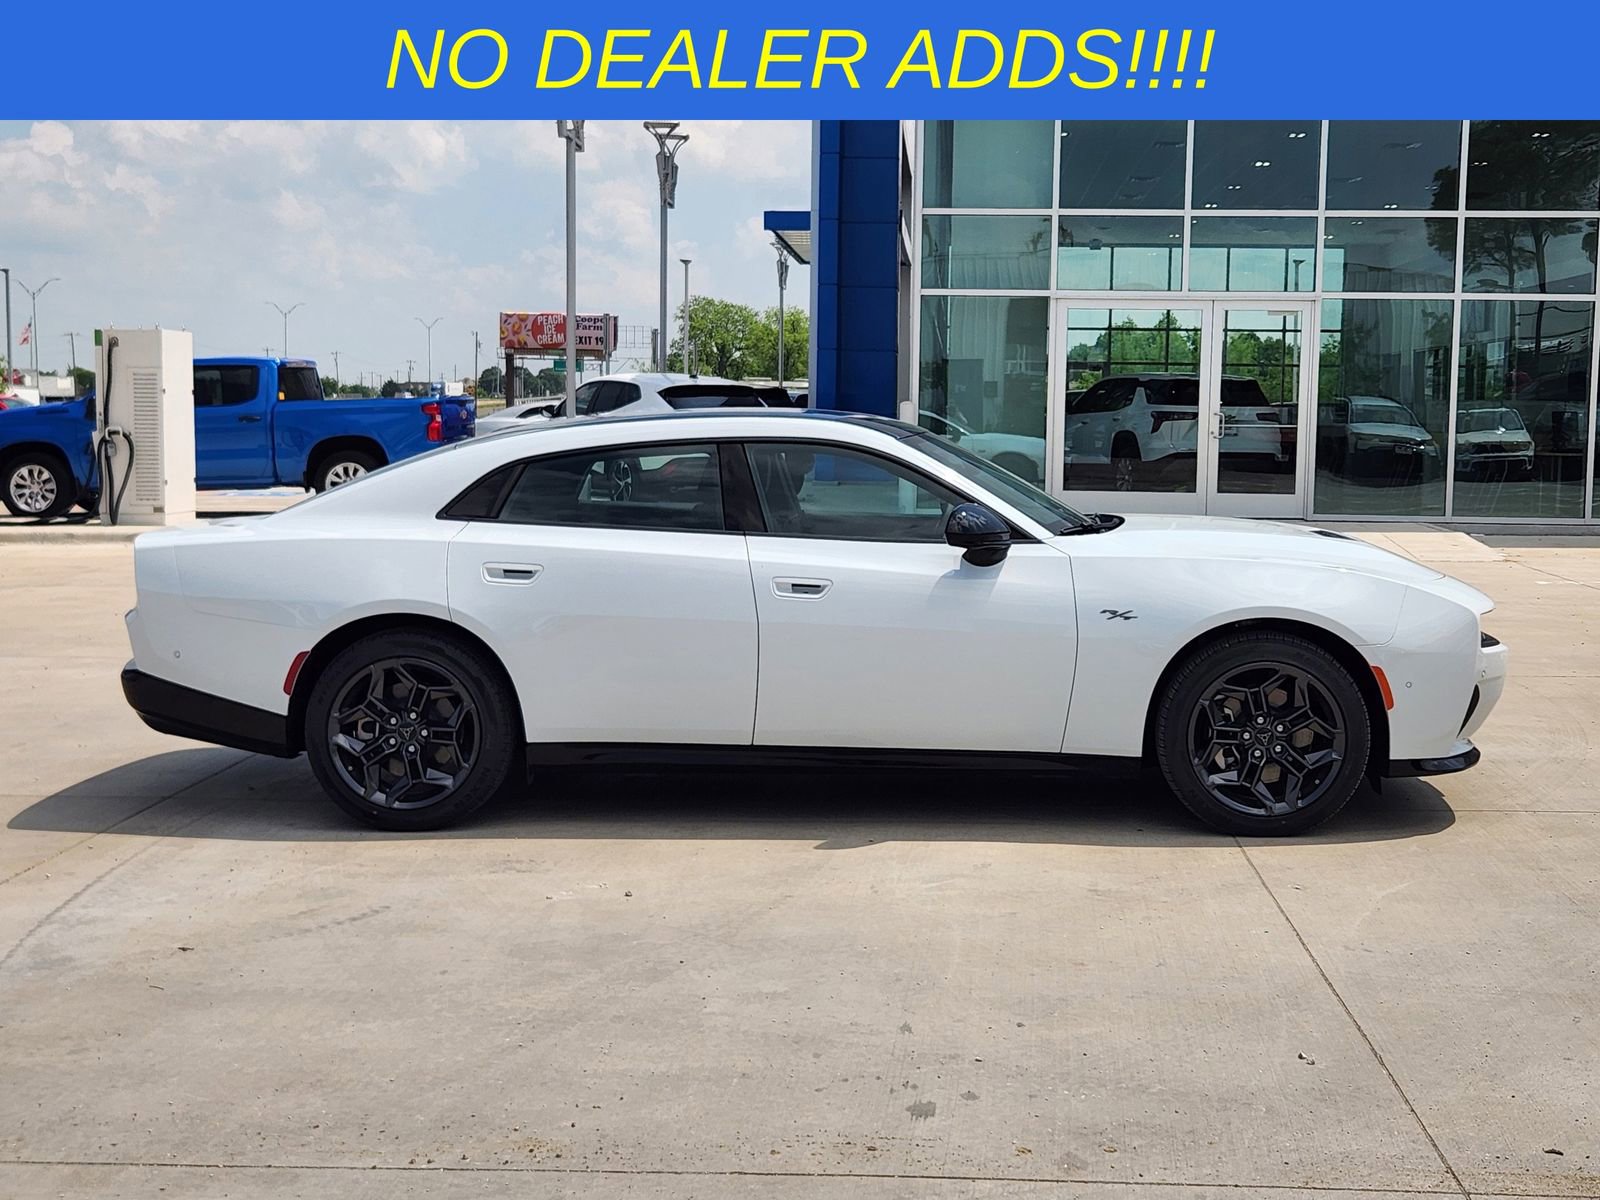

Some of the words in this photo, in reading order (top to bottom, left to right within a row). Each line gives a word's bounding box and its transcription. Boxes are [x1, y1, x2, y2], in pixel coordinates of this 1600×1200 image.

[537, 314, 563, 325] PEACH
[544, 324, 557, 335] ICE
[537, 333, 565, 345] CREAM
